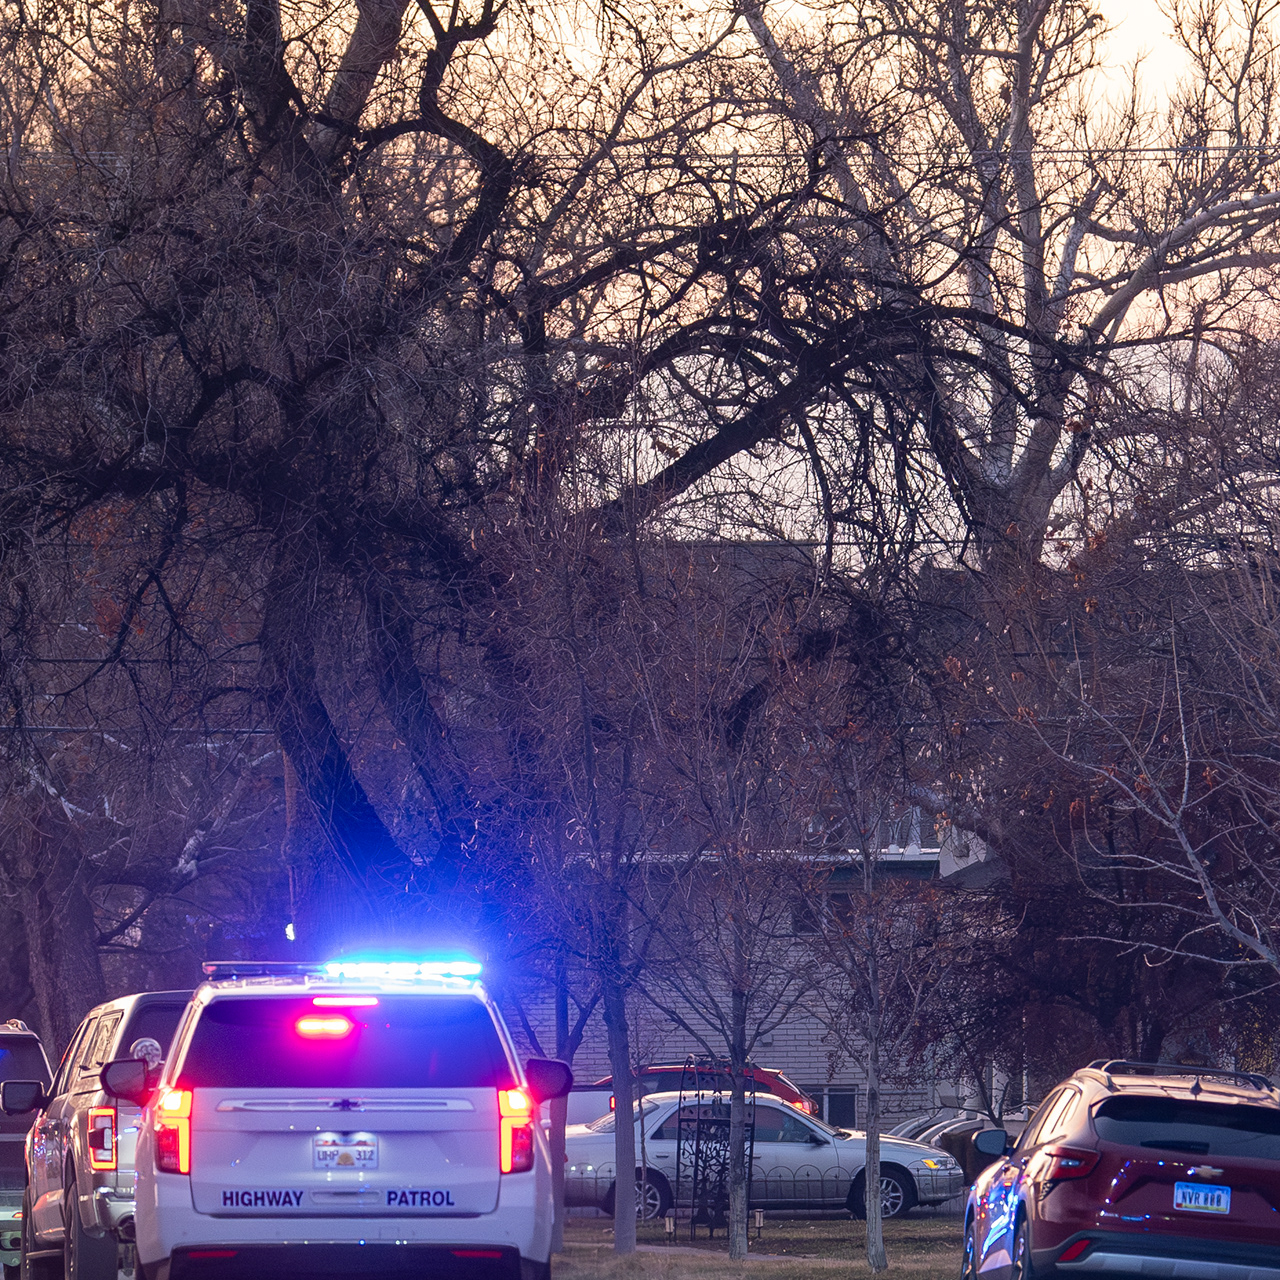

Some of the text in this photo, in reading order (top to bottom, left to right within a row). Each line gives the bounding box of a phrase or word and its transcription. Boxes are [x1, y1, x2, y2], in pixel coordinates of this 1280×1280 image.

[355, 1149, 374, 1161] 312
[222, 1190, 455, 1207] HIGHWAY PATROL
